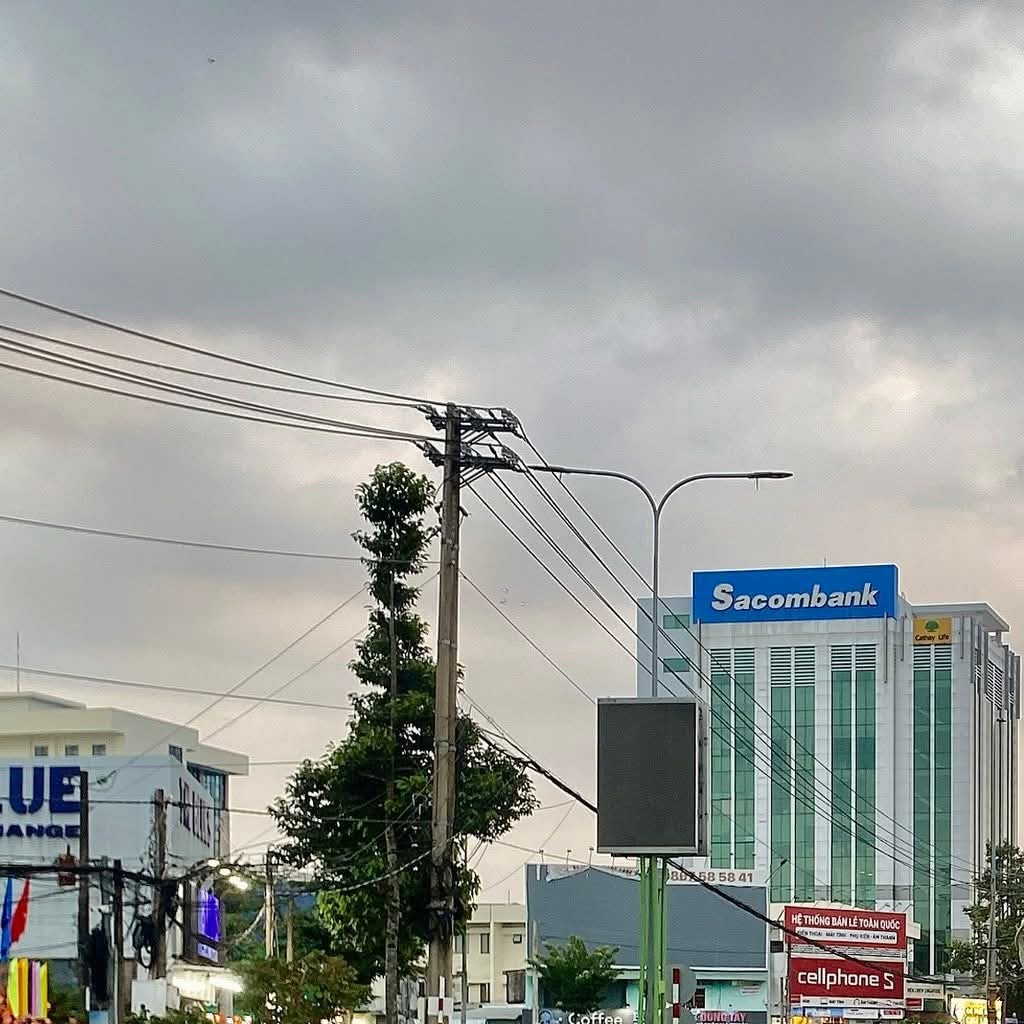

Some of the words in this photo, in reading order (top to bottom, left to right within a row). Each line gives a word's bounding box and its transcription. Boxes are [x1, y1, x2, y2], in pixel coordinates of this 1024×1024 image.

[711, 583, 879, 611] Sacombank
[915, 633, 935, 642] Cathay
[937, 633, 950, 641] Life
[0, 767, 80, 814] UE
[699, 871, 715, 882] 58
[718, 872, 735, 882] 58
[739, 873, 753, 883] 41
[804, 913, 831, 927] THỐNG
[832, 915, 847, 927] BÁN
[859, 917, 879, 929] TOÀN
[880, 918, 901, 930] QUỐC
